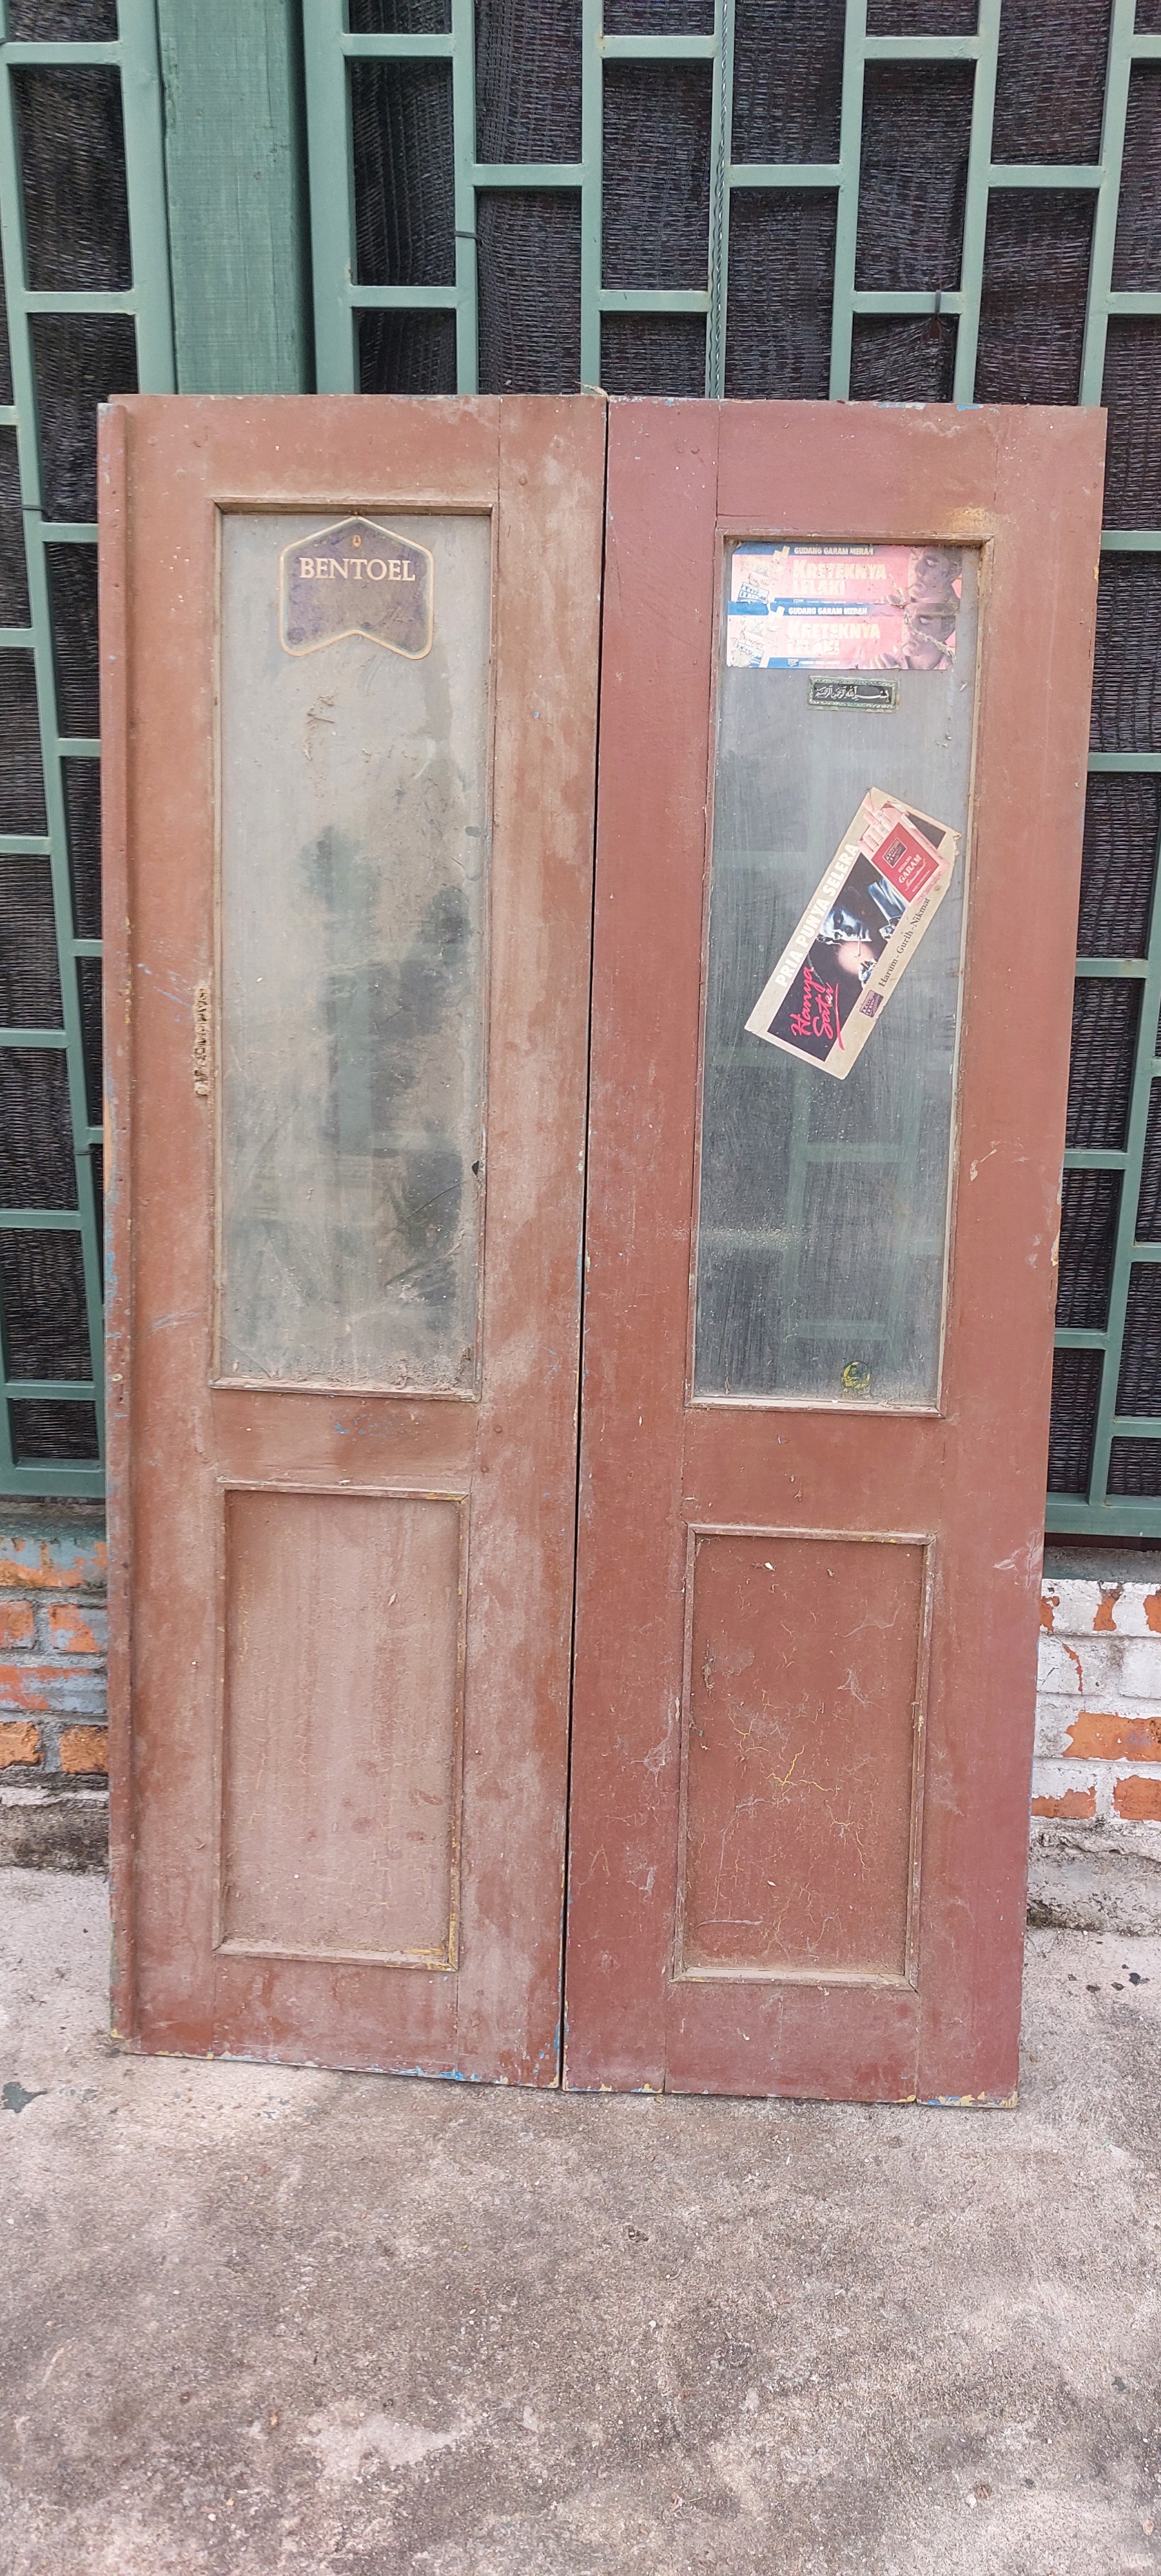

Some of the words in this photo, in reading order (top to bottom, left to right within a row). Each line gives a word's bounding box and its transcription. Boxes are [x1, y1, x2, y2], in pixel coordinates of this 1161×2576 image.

[299, 557, 416, 581] BENTOEL
[899, 854, 923, 883] GARAM
[775, 950, 803, 988] PRIA
[796, 898, 831, 948] PUNYA
[822, 843, 859, 897] SELERA
[879, 958, 898, 987] Harum
[896, 930, 913, 954] Gurih
[910, 897, 931, 927] Nikmat
[790, 967, 826, 1036] Hanya
